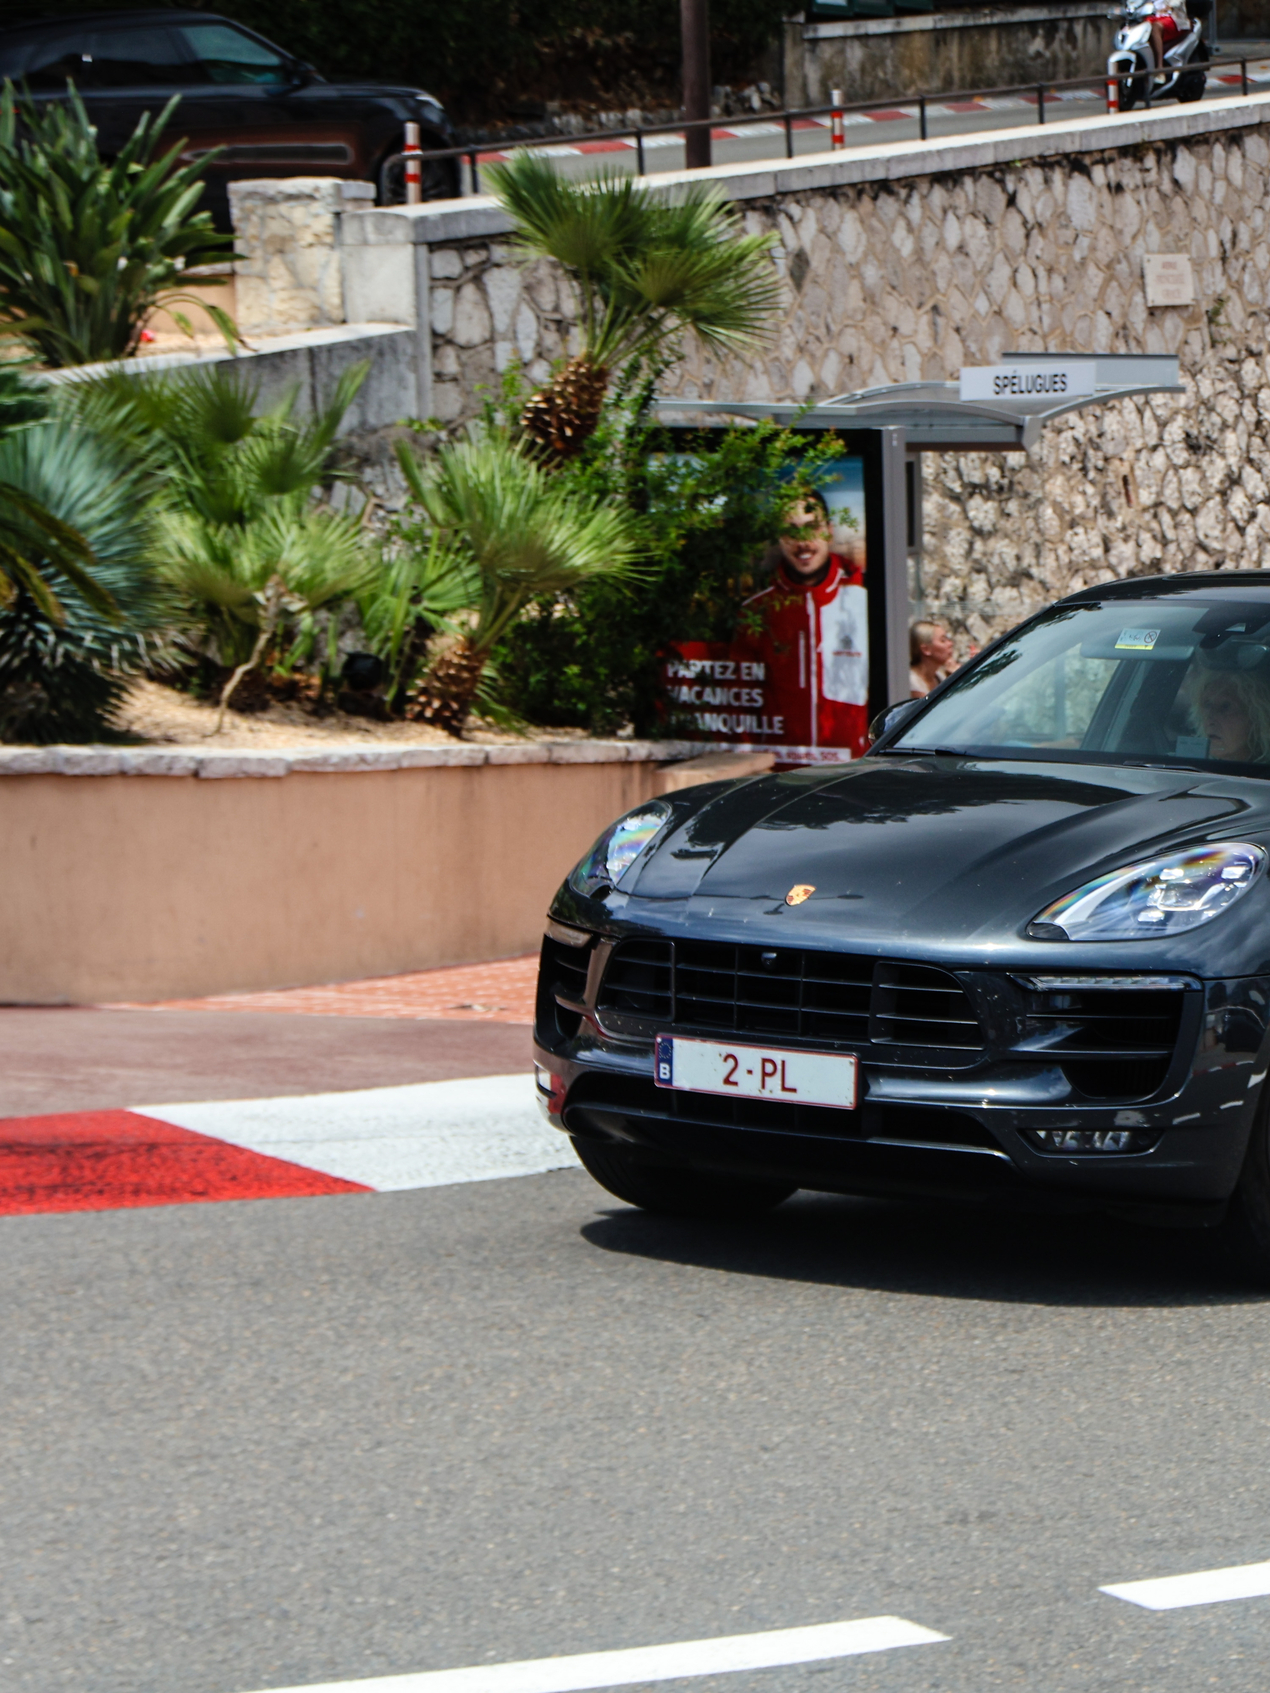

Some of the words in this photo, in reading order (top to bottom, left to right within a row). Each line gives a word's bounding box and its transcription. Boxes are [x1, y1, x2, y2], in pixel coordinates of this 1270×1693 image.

[993, 369, 1067, 395] SPÉLUGUES
[741, 662, 765, 681] EN
[671, 712, 784, 735] ANQUILLE
[659, 1063, 670, 1080] B
